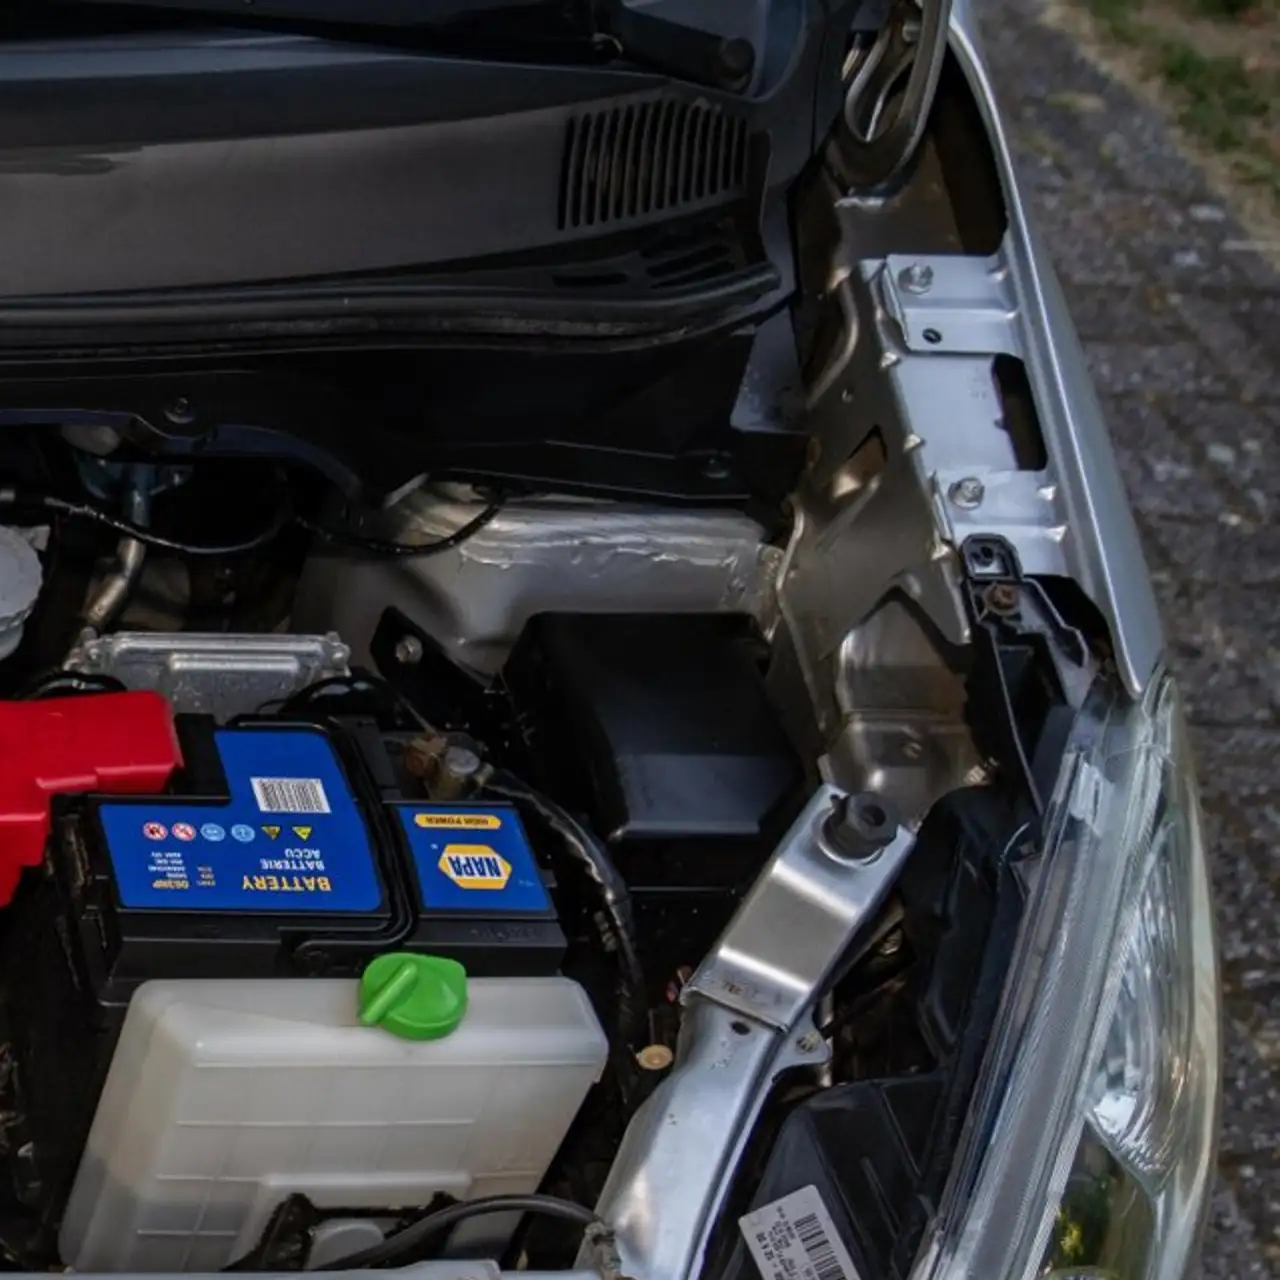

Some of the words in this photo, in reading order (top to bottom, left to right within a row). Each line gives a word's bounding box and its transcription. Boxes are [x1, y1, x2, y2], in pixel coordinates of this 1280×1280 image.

[284, 848, 321, 859] ACCU
[260, 858, 325, 871] BATTERIE
[448, 856, 502, 877] NAPA
[242, 875, 332, 892] BATTERY
